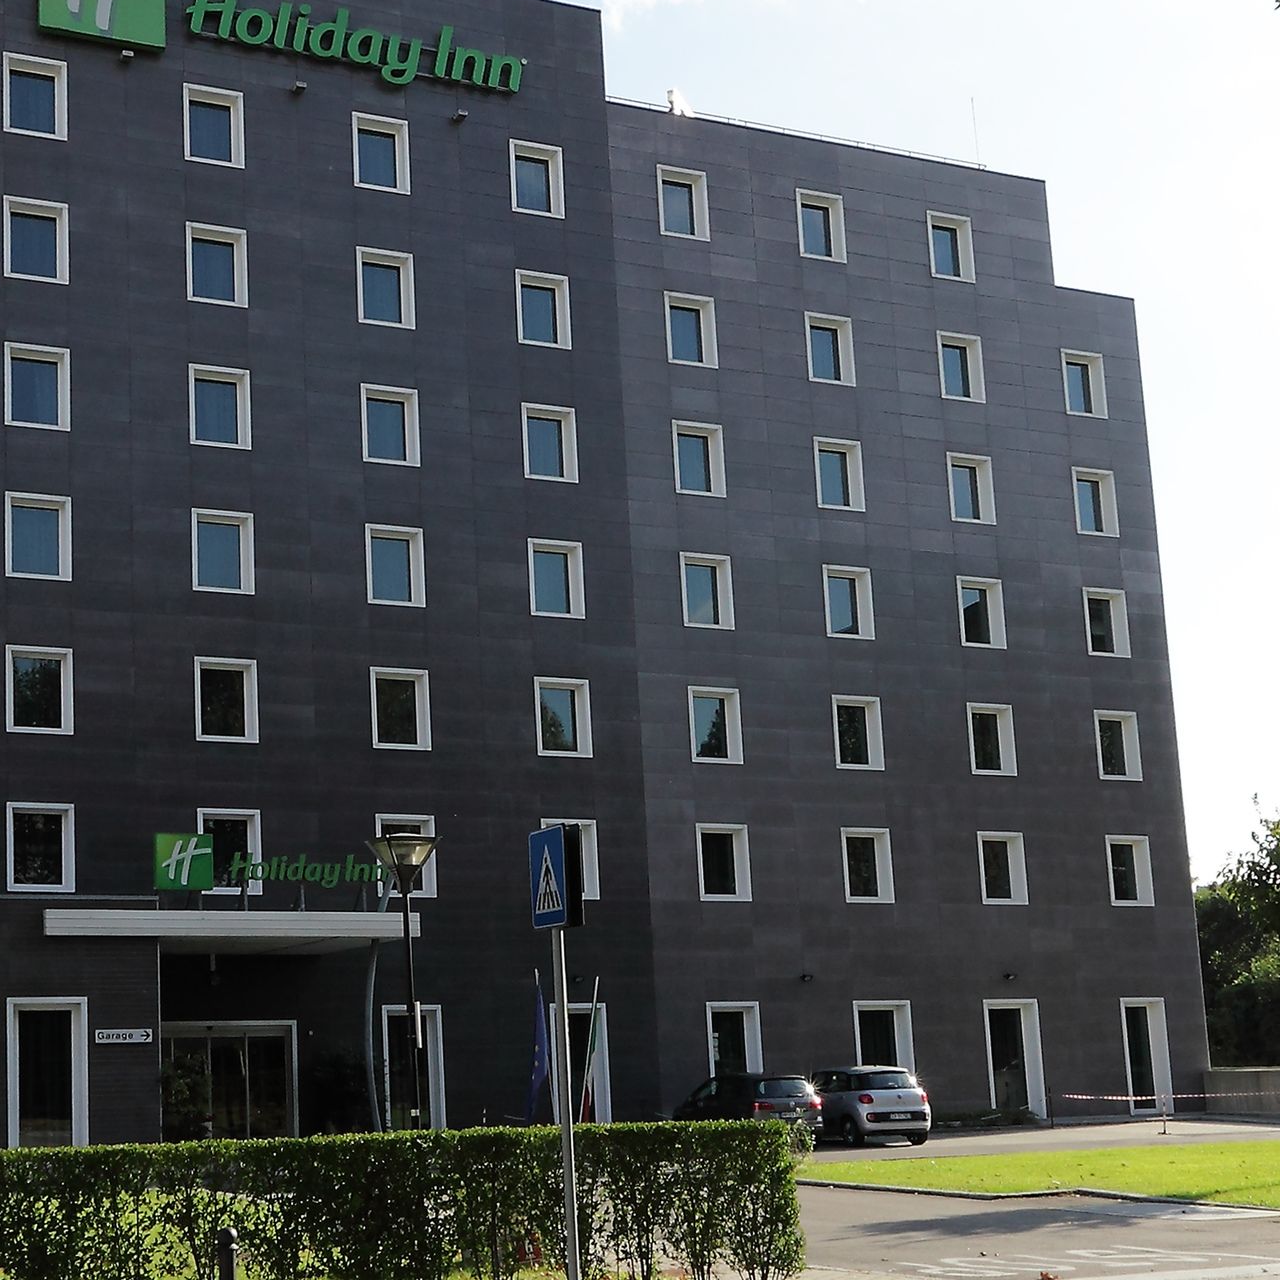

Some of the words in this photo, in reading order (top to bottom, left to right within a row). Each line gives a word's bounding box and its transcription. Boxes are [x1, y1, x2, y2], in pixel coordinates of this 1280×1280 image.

[433, 24, 522, 93] Inn
[229, 851, 342, 889] Holiday
[97, 1031, 134, 1041] Garage
